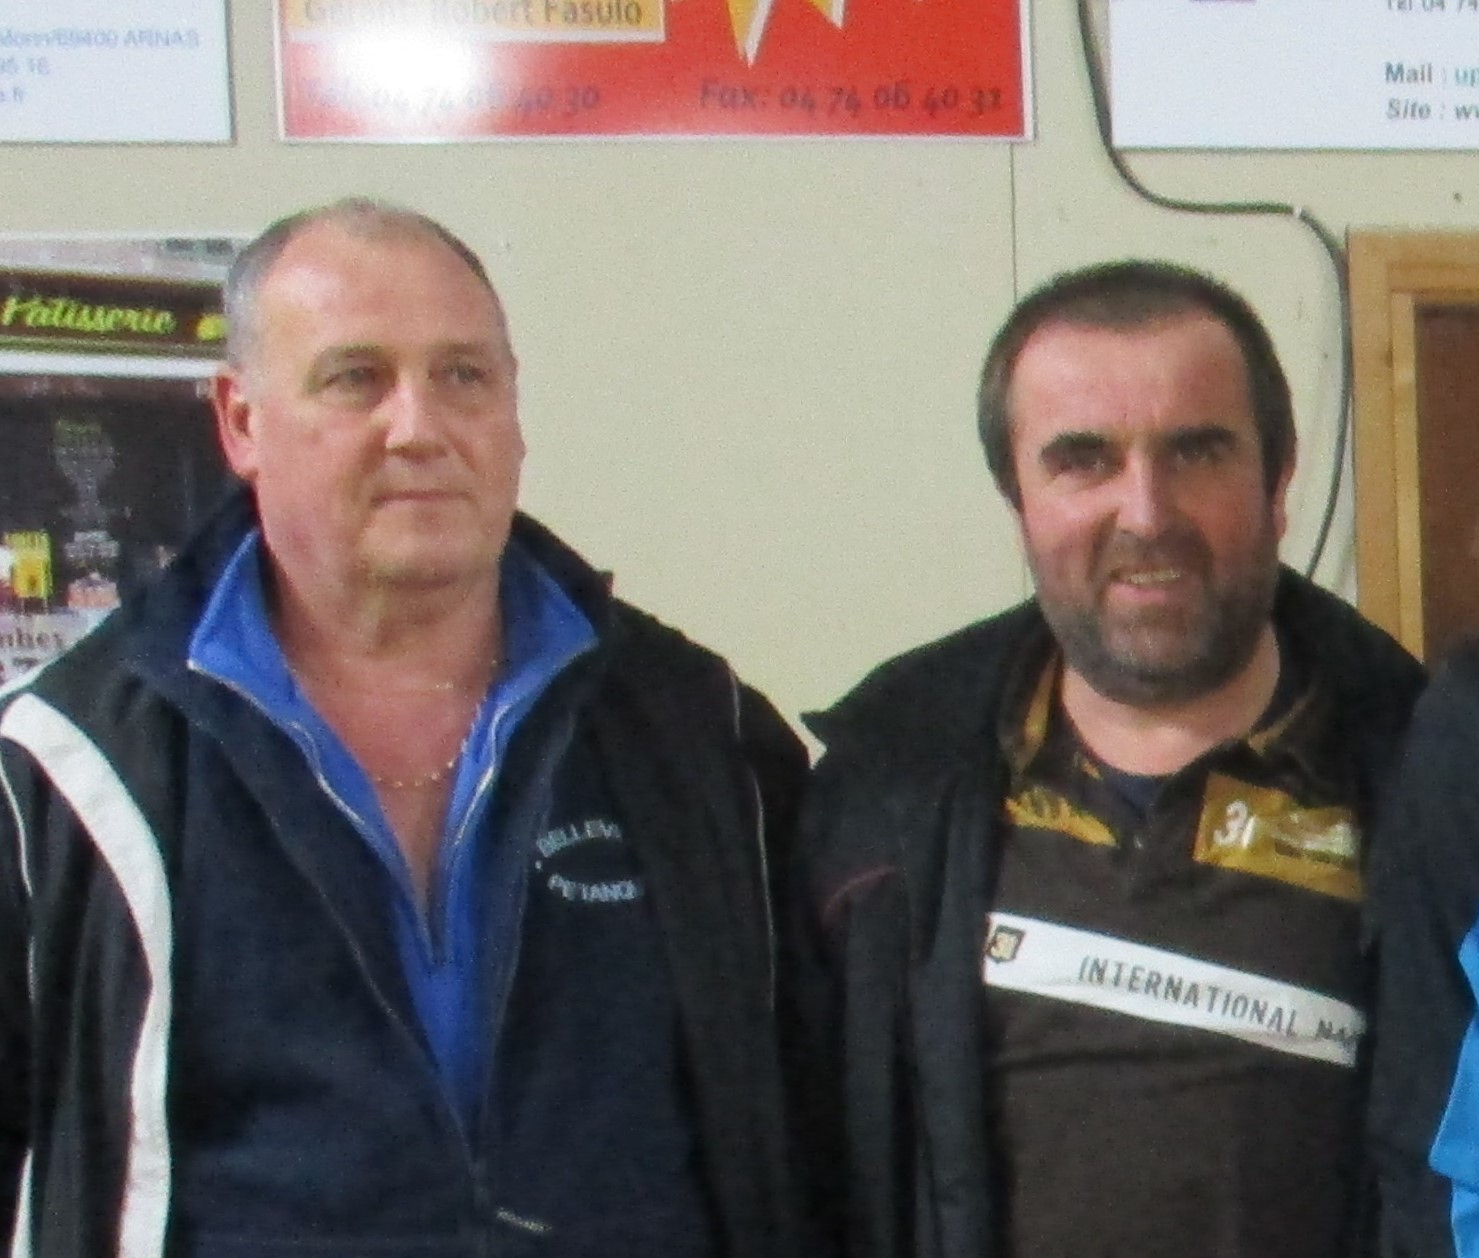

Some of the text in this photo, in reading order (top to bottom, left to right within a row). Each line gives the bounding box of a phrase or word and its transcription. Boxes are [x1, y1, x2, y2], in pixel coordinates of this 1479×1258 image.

[1384, 61, 1434, 85] Mail
[871, 77, 911, 112] 06
[1386, 98, 1432, 121] Site
[1078, 954, 1299, 1039] INTERNATIONAL
